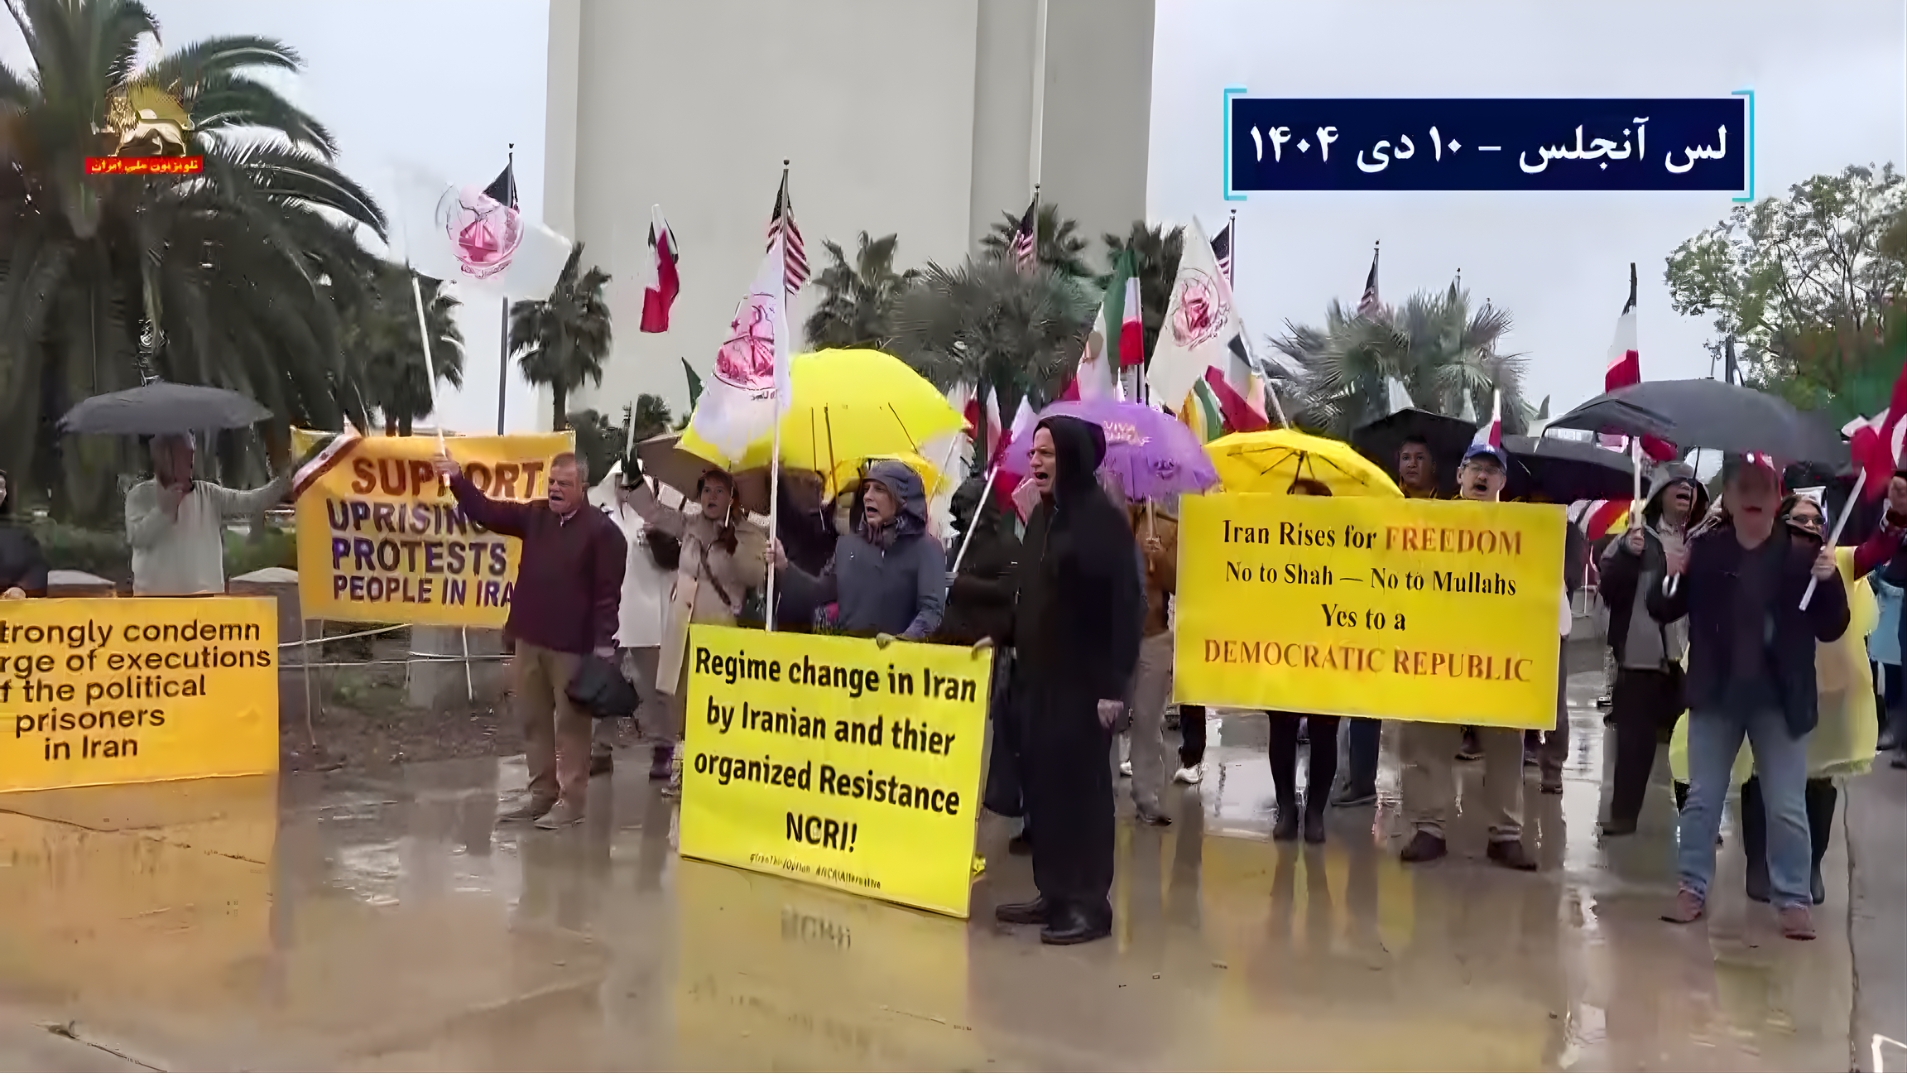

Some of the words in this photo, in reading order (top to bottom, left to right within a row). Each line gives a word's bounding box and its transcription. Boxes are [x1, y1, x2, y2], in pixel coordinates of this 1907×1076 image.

[351, 457, 544, 499] SUPORT
[326, 498, 489, 536] UPRISIN
[1222, 519, 1270, 545] Iran
[1280, 521, 1336, 547] Rises
[1344, 524, 1378, 549] for
[1385, 526, 1522, 556] FREEDOM
[332, 537, 507, 577] PROTESTS
[333, 574, 433, 604] PEOPLE
[441, 578, 467, 606] IN
[1226, 561, 1253, 583] No
[1259, 565, 1277, 584] to
[1284, 562, 1333, 586] Shah
[1370, 567, 1398, 590] No
[1405, 571, 1425, 591] to
[1432, 570, 1517, 596] Mullahs
[0, 619, 113, 648] trongly
[123, 619, 260, 644] condemn
[1321, 603, 1357, 628] Yes
[1365, 608, 1386, 630] to
[1394, 613, 1406, 631] a
[0, 653, 55, 679] rge
[66, 648, 97, 672] of
[107, 645, 271, 671] executions
[695, 647, 781, 685] Regime
[788, 655, 880, 698] change
[888, 664, 913, 695] in
[923, 668, 977, 702] Iran
[1204, 638, 1386, 673] DEMOCRATIC
[1393, 650, 1534, 682] REPUBLIC
[24, 678, 75, 703] the
[86, 674, 207, 705] political
[16, 707, 165, 738] prisoners
[707, 696, 735, 734] by
[742, 701, 826, 739] Iranian
[834, 715, 884, 746] and
[891, 719, 956, 757] thier
[44, 737, 71, 761] in
[82, 735, 138, 759] Iran
[694, 752, 812, 792] organized
[819, 765, 961, 816] Resistance
[786, 812, 858, 853] NCRI!
